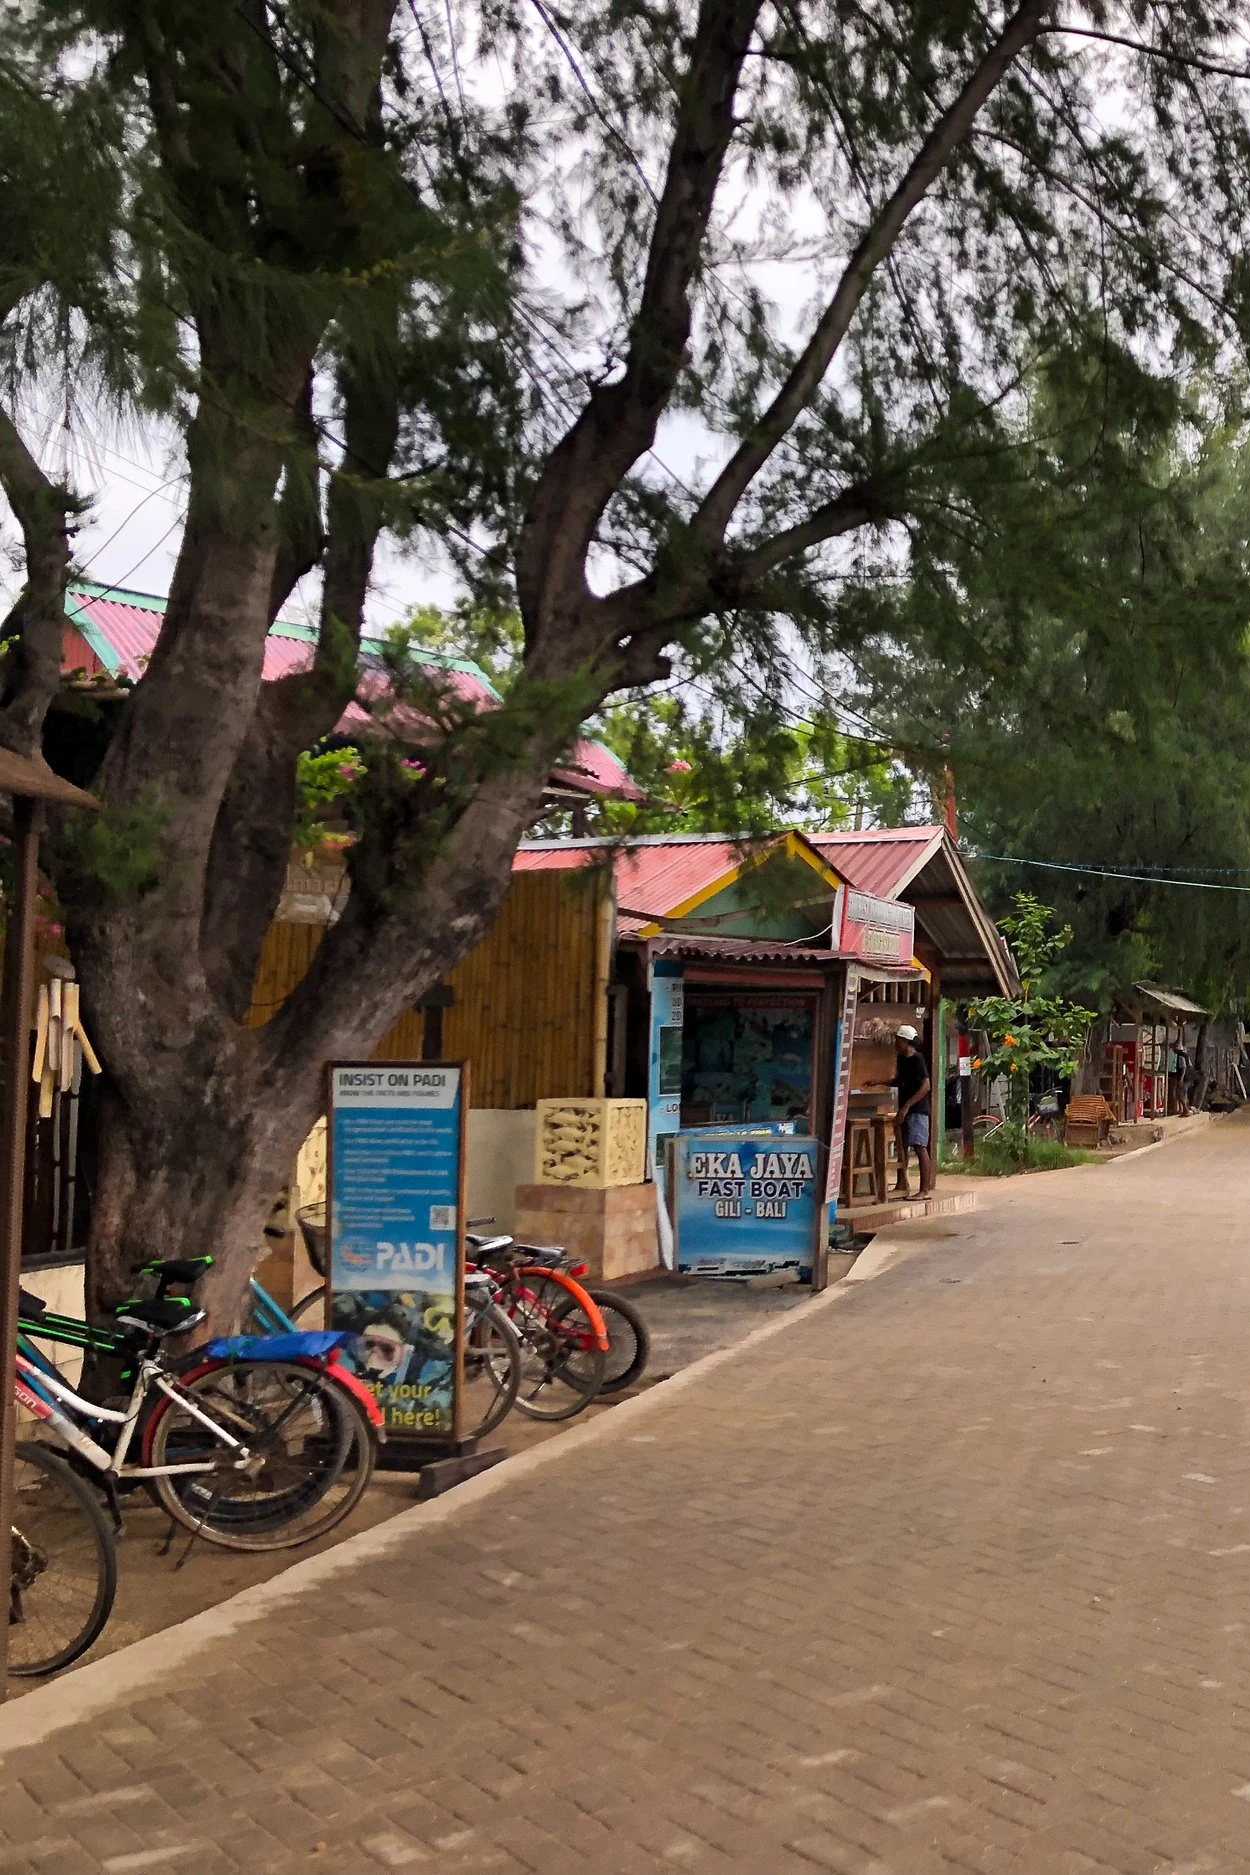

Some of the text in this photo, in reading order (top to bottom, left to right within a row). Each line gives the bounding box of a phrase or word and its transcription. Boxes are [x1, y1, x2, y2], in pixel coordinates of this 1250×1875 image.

[339, 1073, 446, 1087] INSIST ON PADI
[688, 1152, 814, 1180] EKA JAYA
[698, 1180, 805, 1199] FAST BOAT
[715, 1201, 742, 1218] GILI
[756, 1201, 787, 1218] BALI
[376, 1241, 445, 1270] PADI
[388, 1384, 432, 1404] your
[392, 1406, 440, 1426] here!
